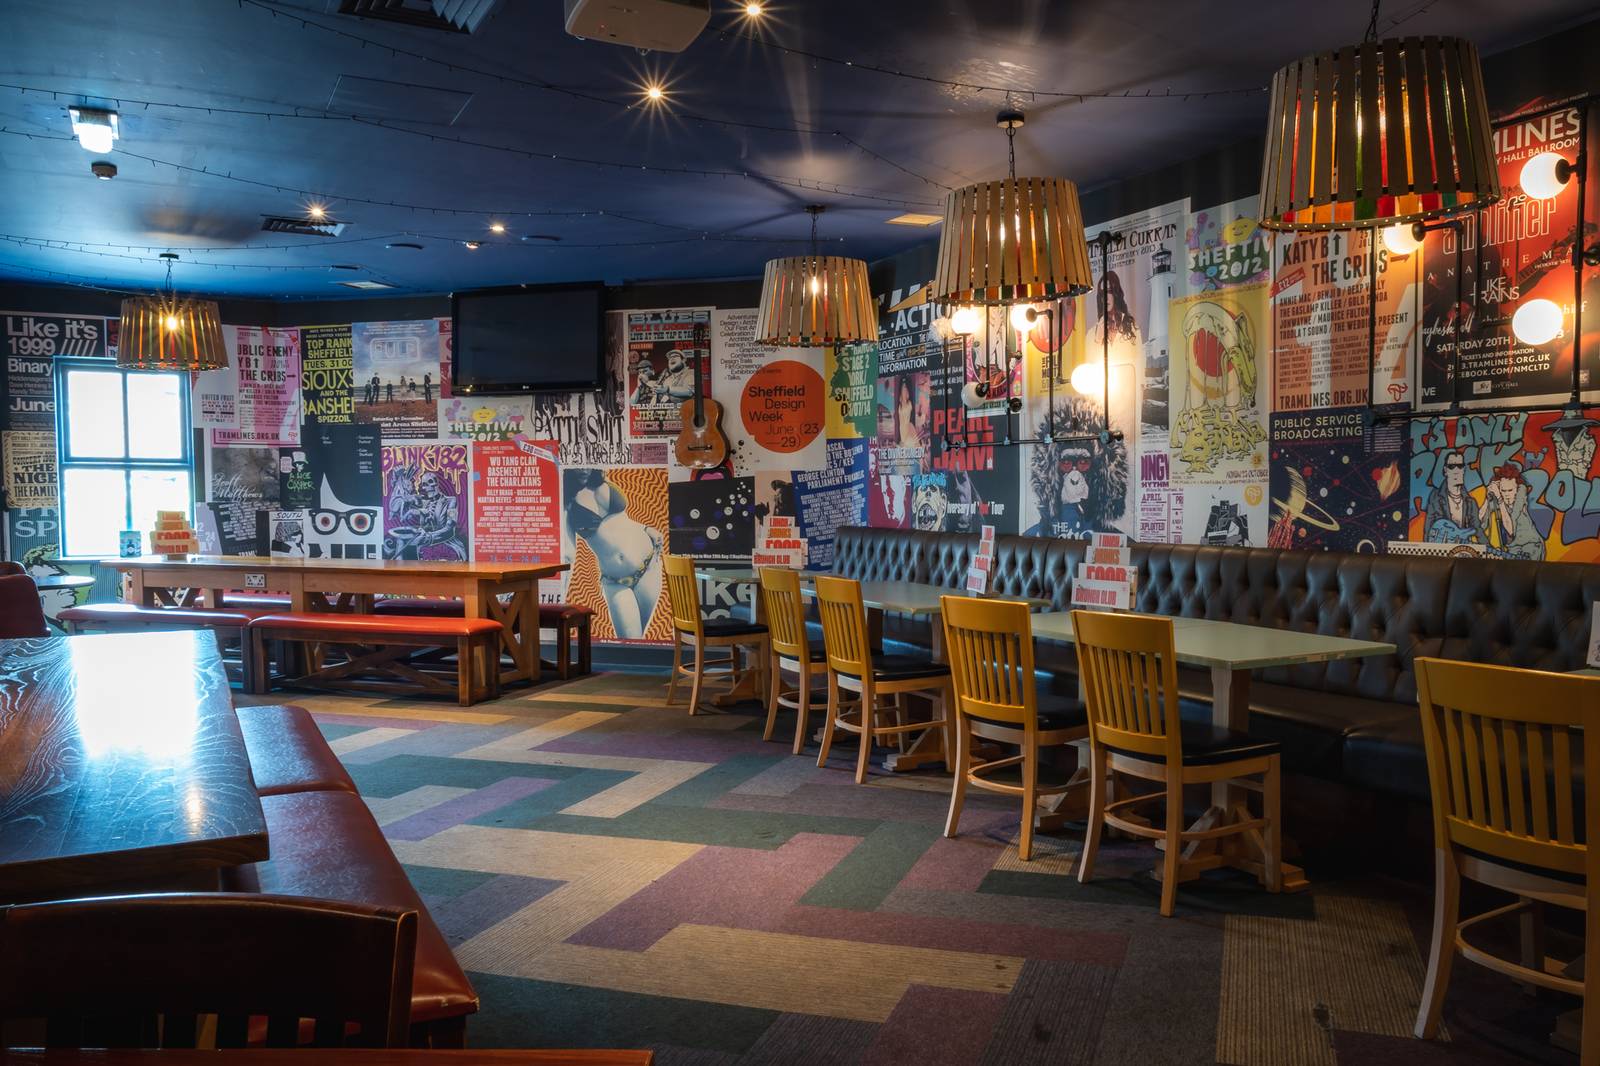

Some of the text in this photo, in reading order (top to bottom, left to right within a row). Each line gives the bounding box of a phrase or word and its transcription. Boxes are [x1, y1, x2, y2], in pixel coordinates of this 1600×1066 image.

[1493, 109, 1580, 155] LINES
[1503, 137, 1580, 163] HALL BALLROOM
[1188, 236, 1271, 269] SHEFTIV
[1219, 257, 1262, 279] 2012
[1312, 250, 1388, 286] THE CRIS
[1280, 280, 1385, 307] ANNIE MAC DEAP VLLY
[1280, 292, 1388, 318] THE GASLAMP KILLER GOLD PNDA
[1318, 310, 1344, 324] MAURICE
[1346, 307, 1370, 319] FULTON
[7, 317, 98, 340] Like it's
[1307, 323, 1327, 336] SOUND
[1334, 321, 1345, 332] THE
[1347, 317, 1376, 330] WEDDIG
[1378, 312, 1408, 325] PRESENT
[8, 337, 56, 356] 1999
[306, 339, 324, 350] TOP
[879, 336, 912, 350] LOCATION
[1486, 337, 1510, 346] 20TH
[238, 345, 293, 356] UBLIC ENEMY
[879, 351, 895, 362] TIME
[1495, 348, 1534, 358] INFORMATION
[8, 358, 54, 376] Binary
[305, 360, 339, 369] TUES. 31
[842, 355, 870, 371] STAGE 2
[879, 357, 927, 373] INFORMATION
[1447, 354, 1550, 371] 23.TRAMLINES.ORG.UK
[240, 370, 286, 381] THE CRIBS
[1447, 364, 1550, 380] FAEBOOK.COM/NMCLTD
[749, 386, 805, 397] Sheffield
[10, 398, 55, 411] June
[765, 399, 805, 411] Design
[1280, 389, 1368, 409] TRAMLINES.ORG.UK
[749, 411, 783, 421] Week
[1274, 413, 1362, 429] PUBLIC SERVICE
[218, 431, 279, 440] TRAMLINES.ORG.UK
[766, 424, 794, 434] June
[1274, 425, 1363, 441] BROADCASTING
[1409, 416, 1447, 452] T'S
[1455, 411, 1528, 448] ONLY
[470, 433, 501, 441] 2012
[827, 441, 845, 451] ASCAL
[934, 433, 993, 471] JAM
[490, 456, 537, 466] WU TANG CLAN
[488, 467, 540, 476] BASEMENT JAXX
[797, 469, 845, 482] GEORGE CLINTON
[14, 473, 57, 484] NICE
[486, 477, 541, 486] THE CHARLATANS
[808, 477, 844, 490] PARLIAMENT
[1142, 493, 1161, 501] APRIL
[947, 502, 969, 516] iversary
[1052, 521, 1069, 532] THE
